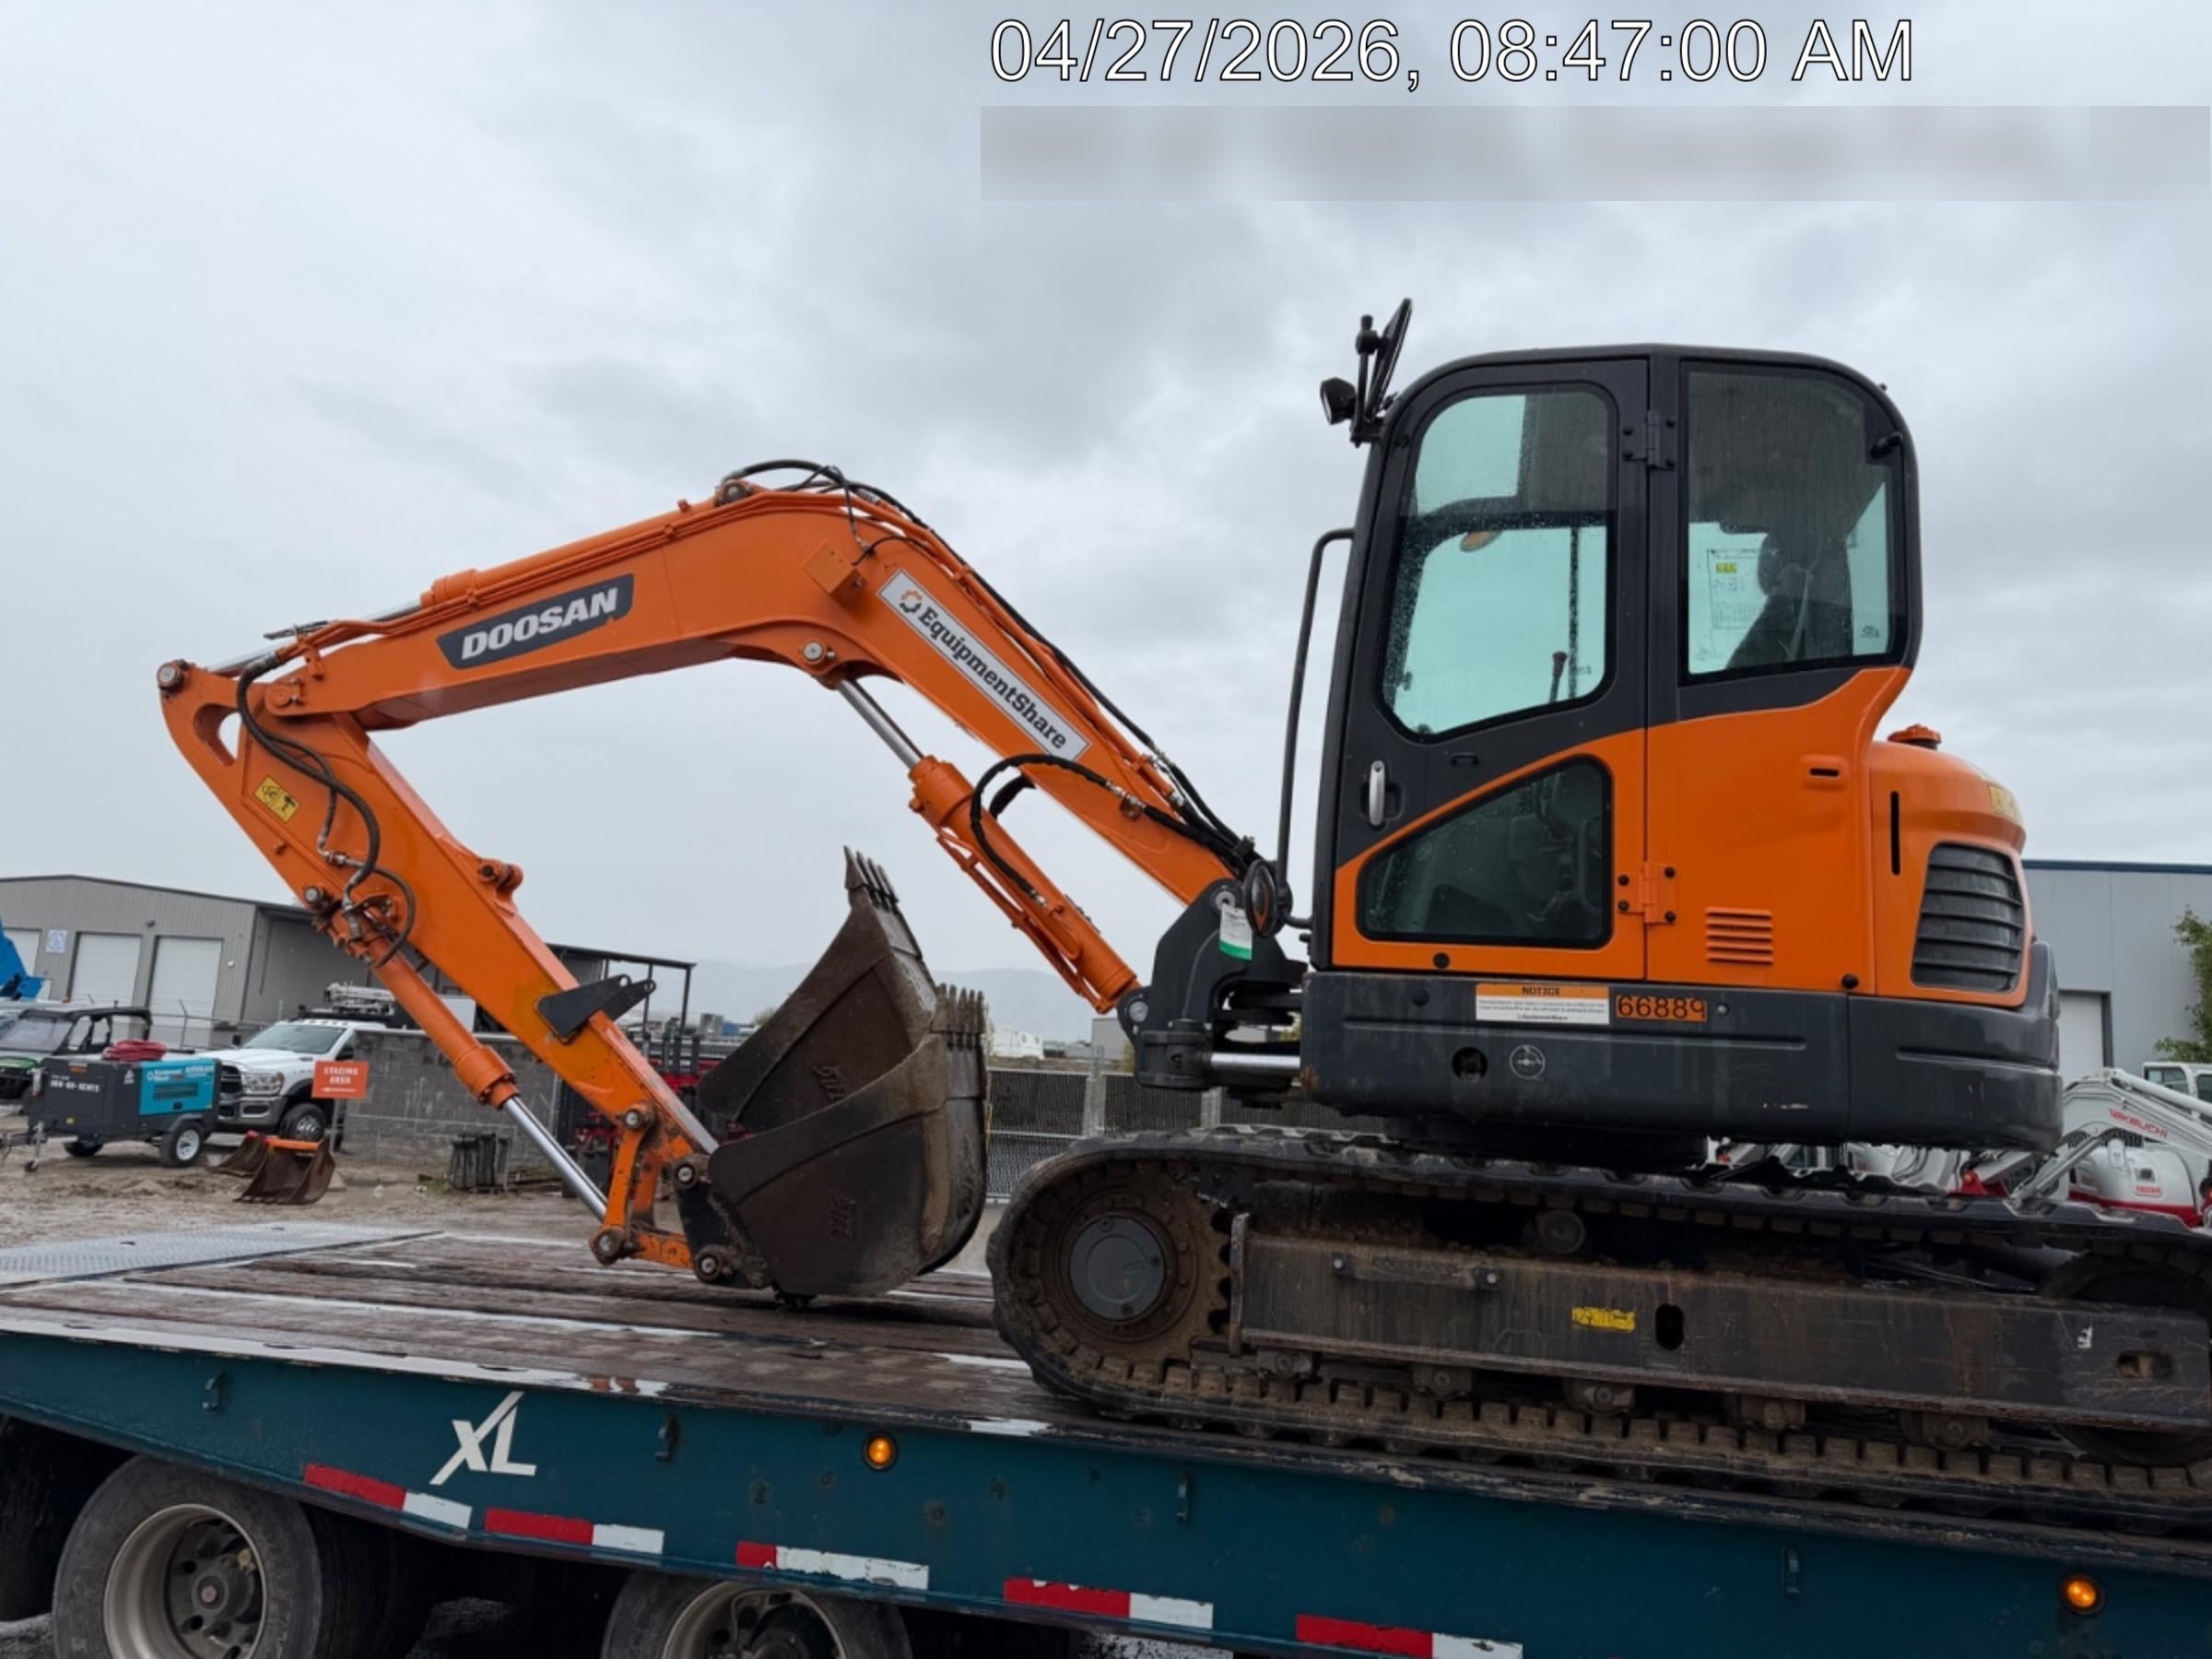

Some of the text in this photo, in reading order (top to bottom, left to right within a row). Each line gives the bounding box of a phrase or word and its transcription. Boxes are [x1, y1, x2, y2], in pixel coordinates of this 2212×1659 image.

[461, 587, 618, 660] DOOSAN
[918, 605, 1067, 749] EquipmentShare
[1522, 986, 1561, 996] NOTICE
[1618, 994, 1706, 1020] 66889
[429, 1391, 537, 1486] XL
